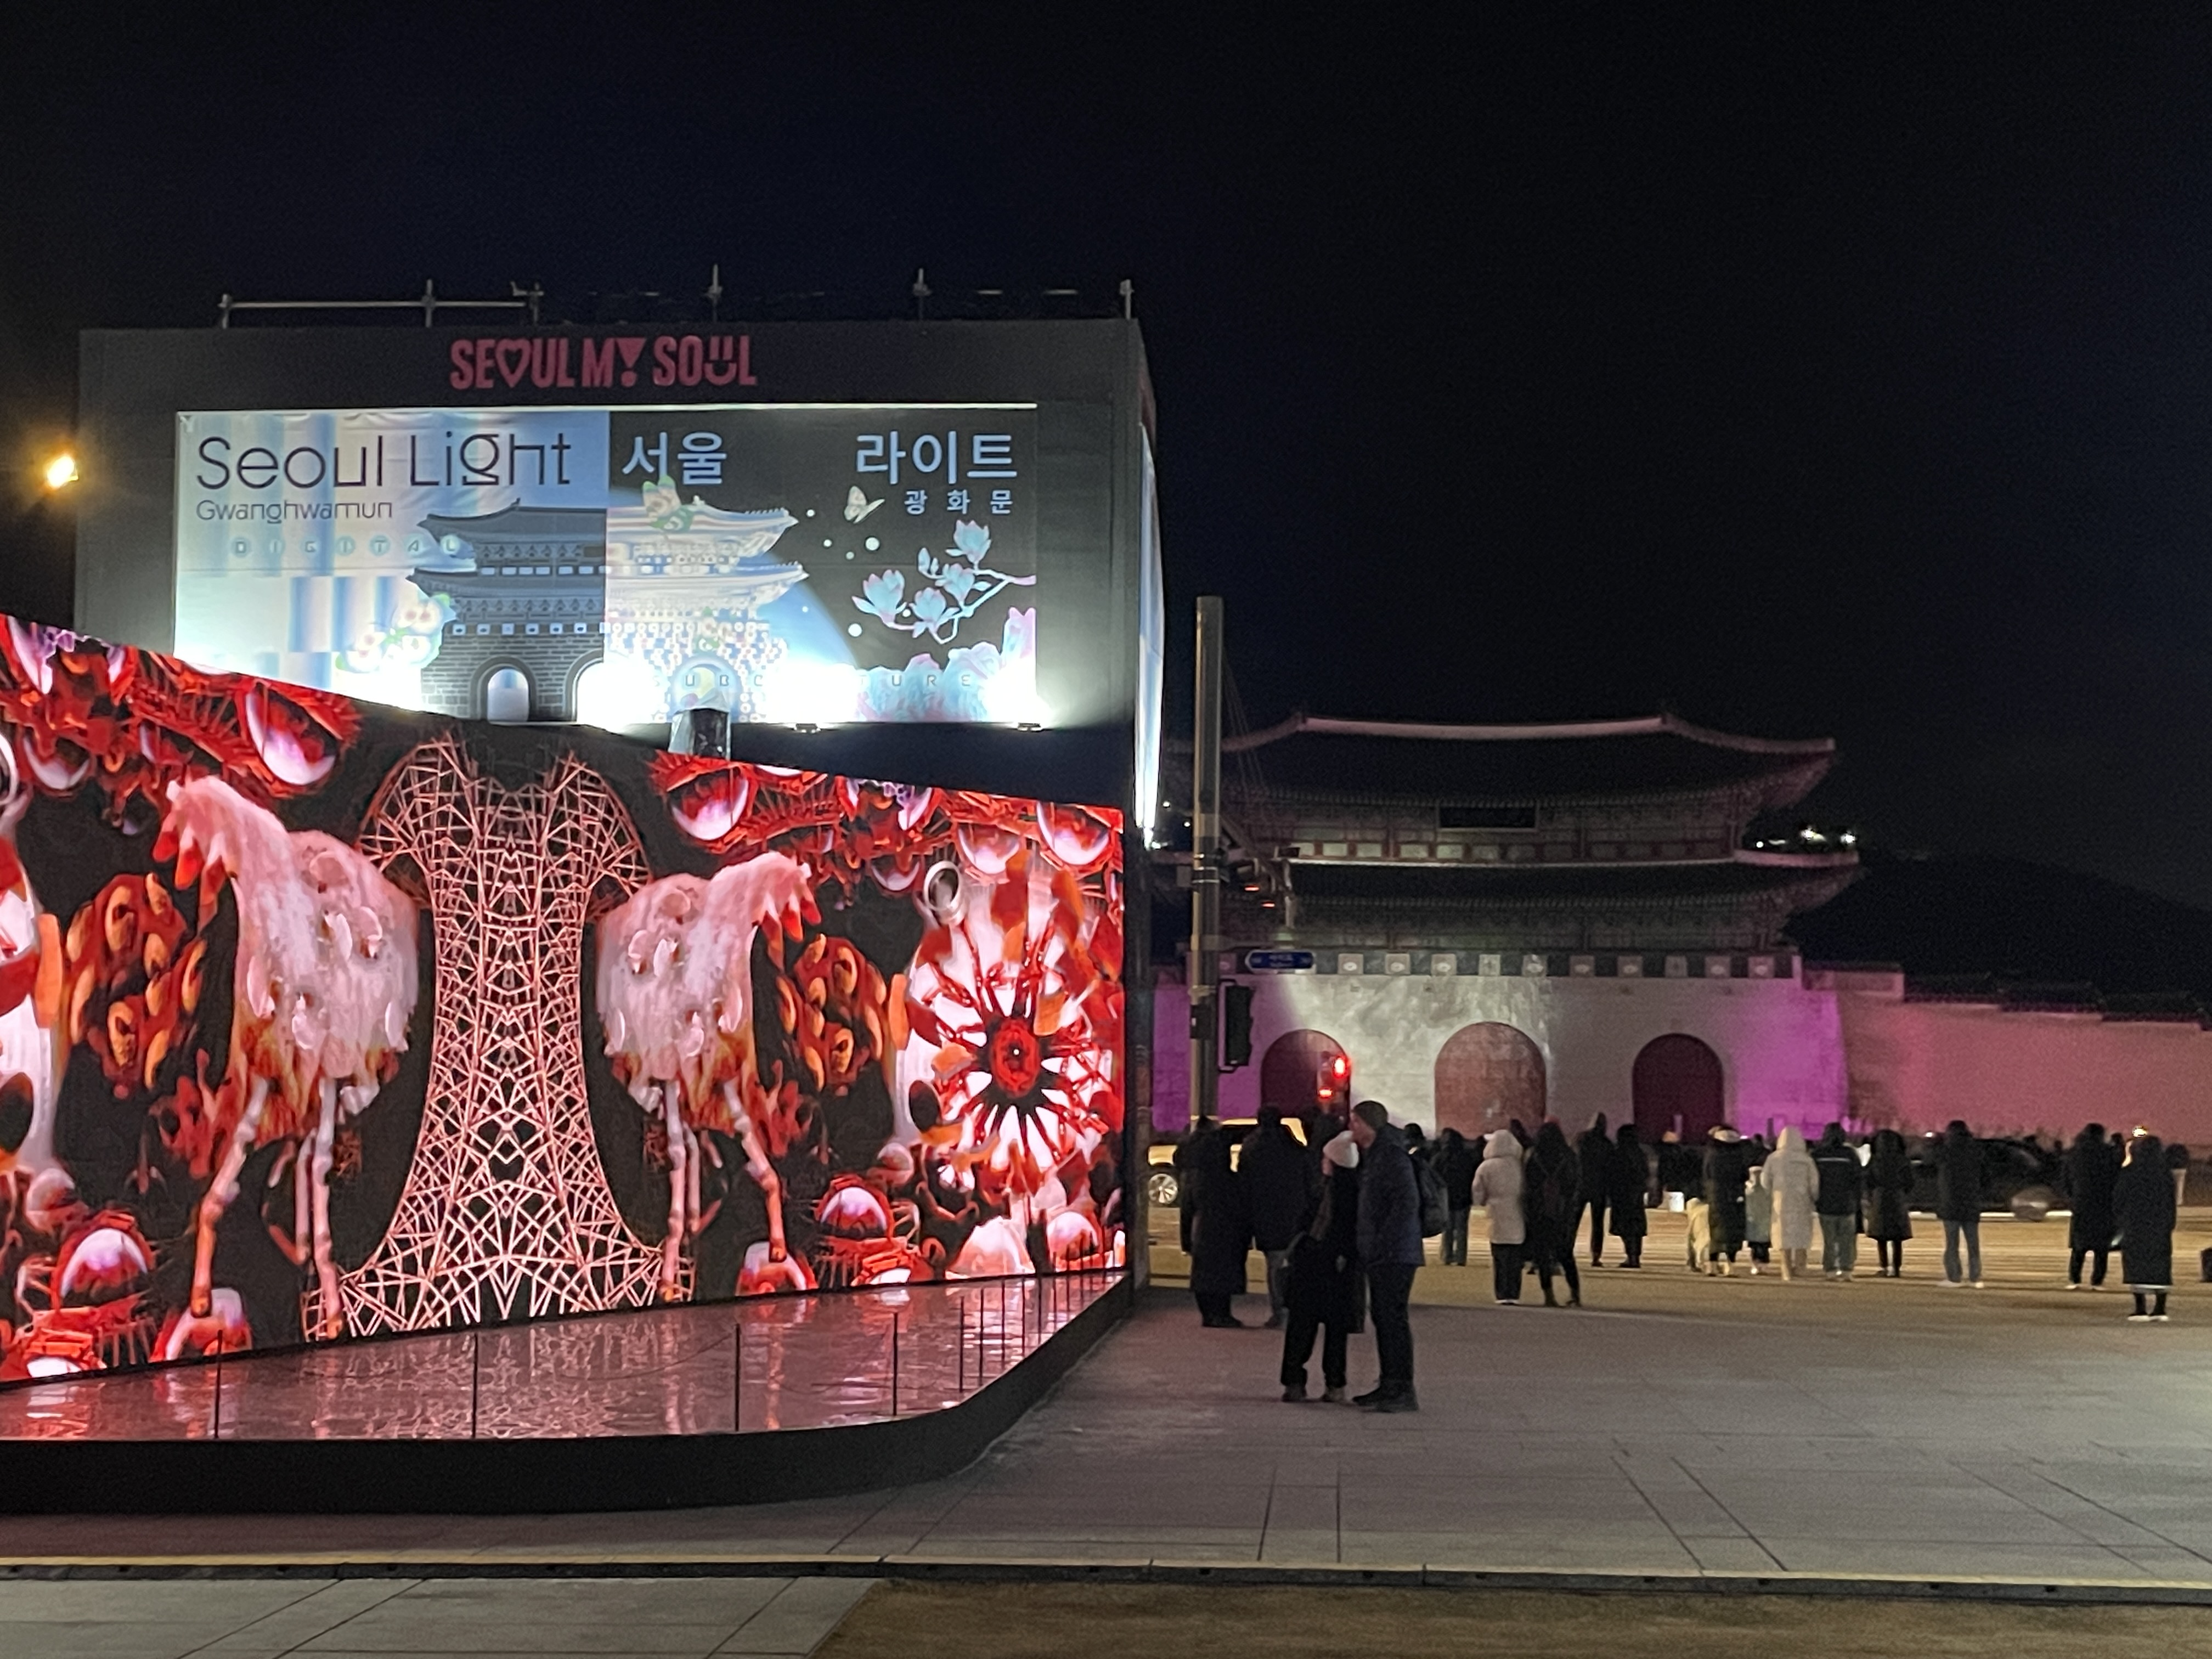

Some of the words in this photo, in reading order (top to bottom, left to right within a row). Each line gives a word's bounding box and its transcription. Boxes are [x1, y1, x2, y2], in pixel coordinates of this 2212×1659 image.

[450, 338, 575, 390] SEOUL
[653, 335, 758, 386] SOUL
[196, 435, 383, 490] Seoul
[410, 431, 571, 486] Light
[622, 432, 727, 485] 서울
[856, 430, 1018, 485] 라이트
[196, 499, 393, 524] Gwanghwamun
[904, 489, 1013, 516] 광화문
[235, 538, 456, 555] DIGITAL
